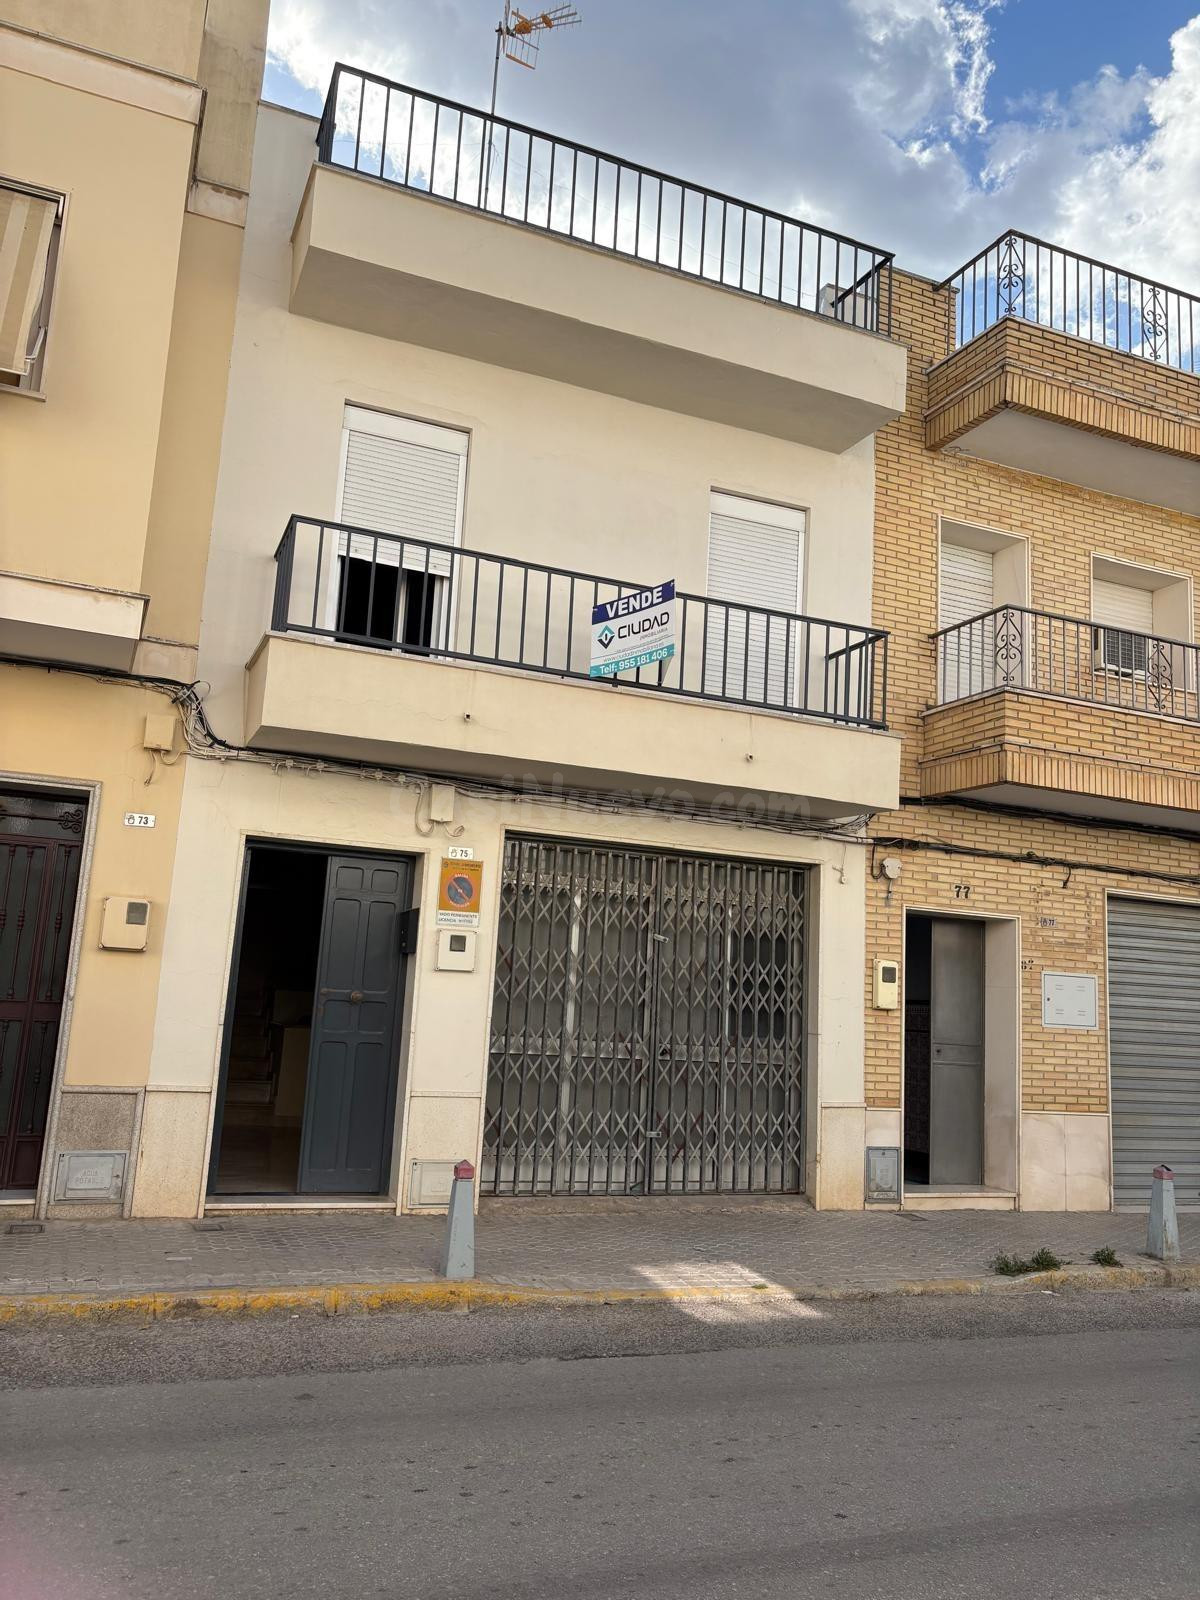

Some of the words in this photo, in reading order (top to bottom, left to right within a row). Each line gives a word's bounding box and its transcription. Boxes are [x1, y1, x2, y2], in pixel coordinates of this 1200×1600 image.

[605, 586, 663, 618] VENDE
[617, 611, 670, 639] CIUDAD
[600, 664, 618, 675] Telf:
[619, 658, 636, 670] 955
[637, 654, 650, 666] 181
[651, 648, 668, 661] 406
[138, 816, 149, 825] 73
[460, 849, 468, 857] 75
[954, 885, 970, 898] 77
